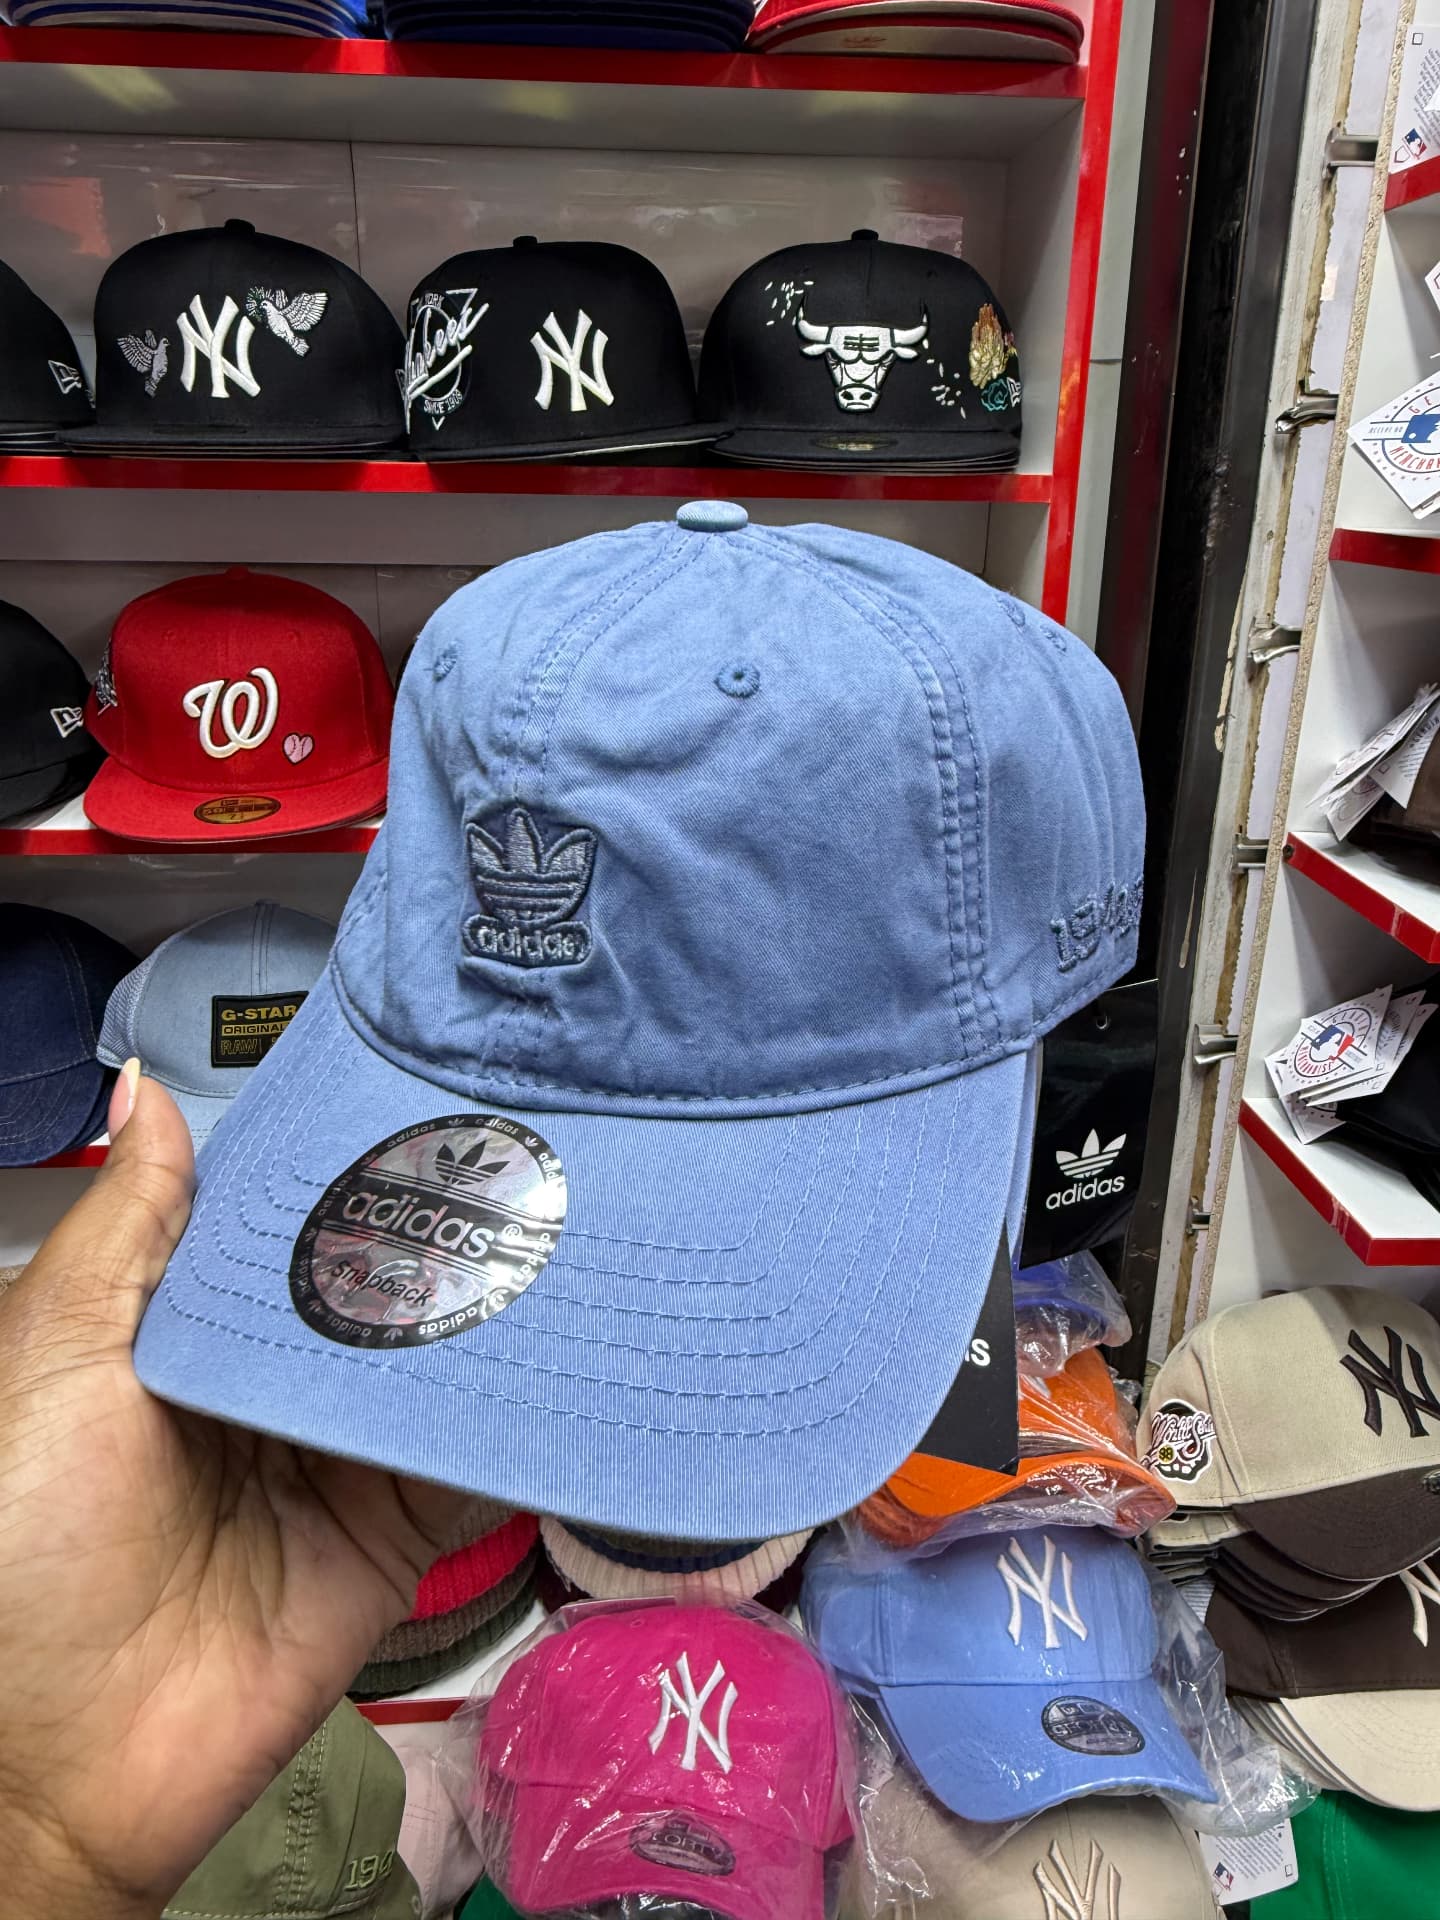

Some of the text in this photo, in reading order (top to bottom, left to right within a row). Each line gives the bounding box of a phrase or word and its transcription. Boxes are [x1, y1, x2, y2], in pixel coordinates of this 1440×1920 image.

[177, 294, 261, 398] NY
[529, 309, 614, 412] NY
[182, 667, 279, 759] W
[221, 1004, 297, 1021] G-STAR
[223, 1023, 290, 1035] ORIGINAL
[475, 1118, 519, 1135] adidas
[1045, 1175, 1126, 1210] adidas
[418, 1306, 478, 1335] adidas
[1339, 1326, 1440, 1437] NY
[996, 1535, 1087, 1649] NY
[648, 1650, 738, 1774] NY
